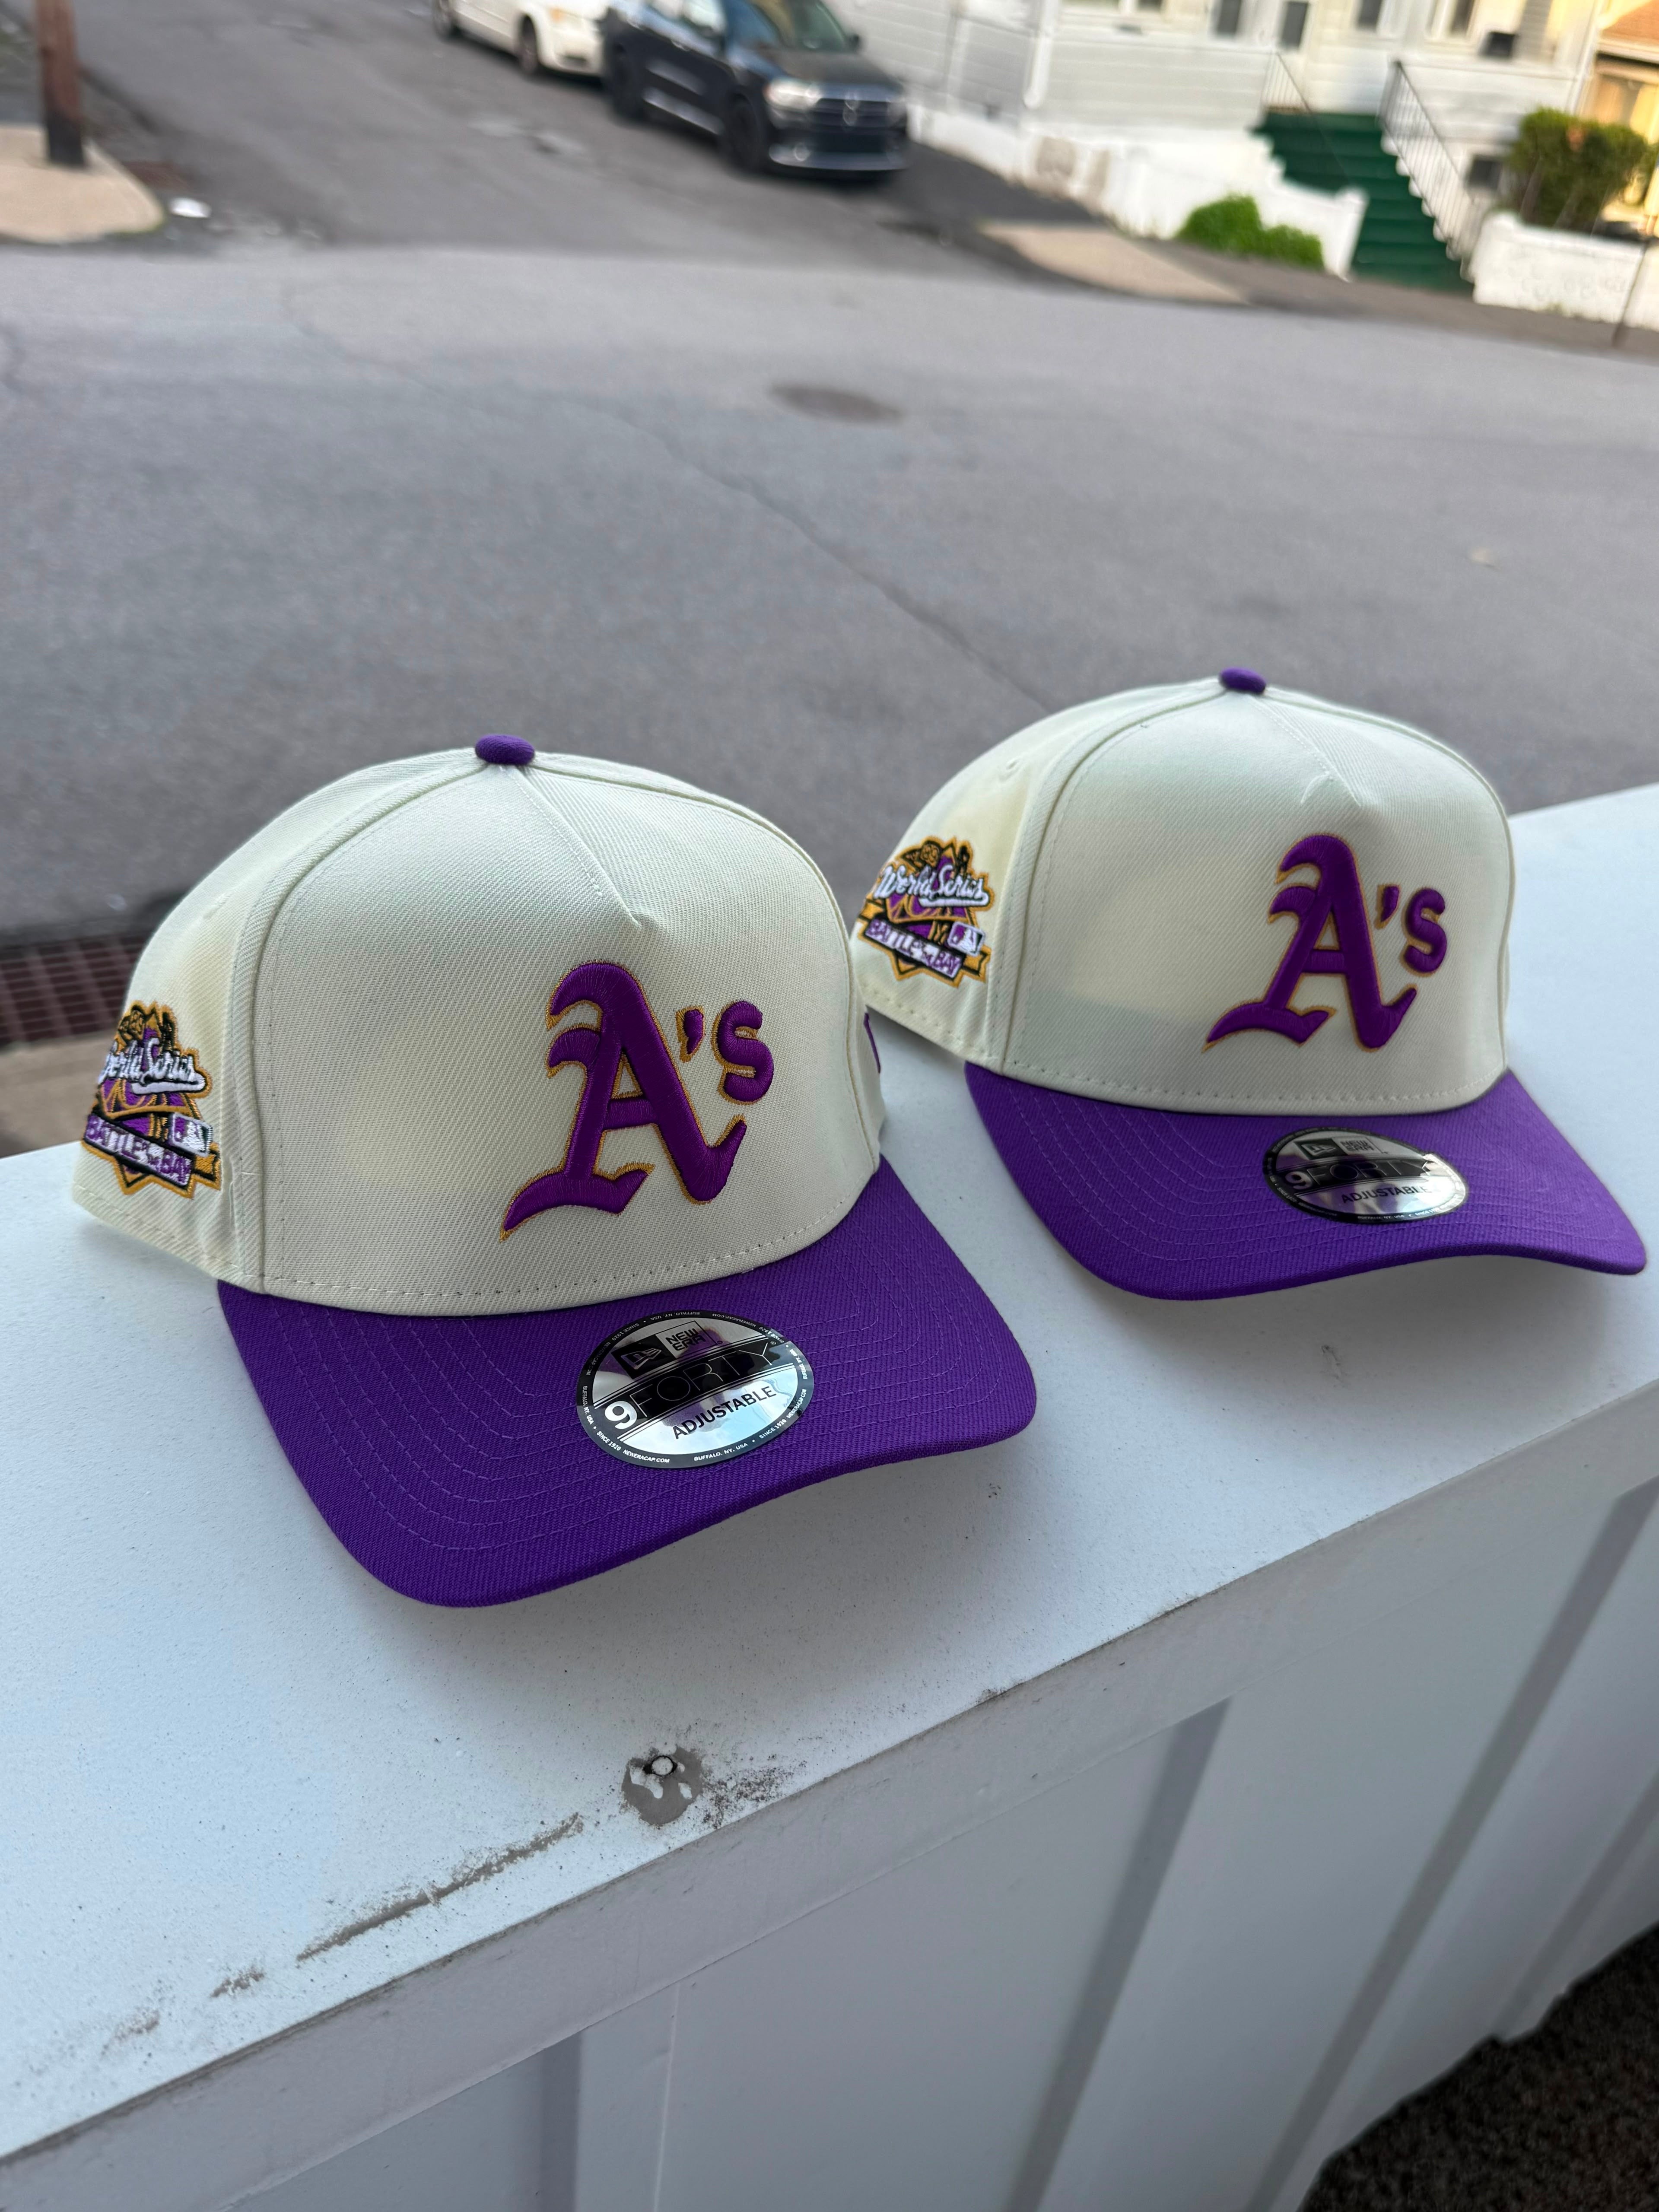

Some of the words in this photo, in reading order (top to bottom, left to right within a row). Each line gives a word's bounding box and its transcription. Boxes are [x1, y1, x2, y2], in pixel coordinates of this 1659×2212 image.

[873, 864, 937, 899] World
[931, 864, 988, 900] Series
[1201, 833, 1447, 1054] A's
[499, 960, 774, 1242] A's
[612, 1331, 624, 1341] 1920
[624, 1323, 639, 1333] SINCE
[665, 1328, 699, 1344] NEW
[672, 1335, 706, 1351] ERA
[672, 1386, 777, 1440] ADJUSTABLE
[759, 1427, 775, 1439] SINCE
[774, 1419, 787, 1430] 1920
[597, 1430, 610, 1444] SINCE
[608, 1441, 622, 1451] 1920
[623, 1449, 670, 1463] NEWERACAP.COM
